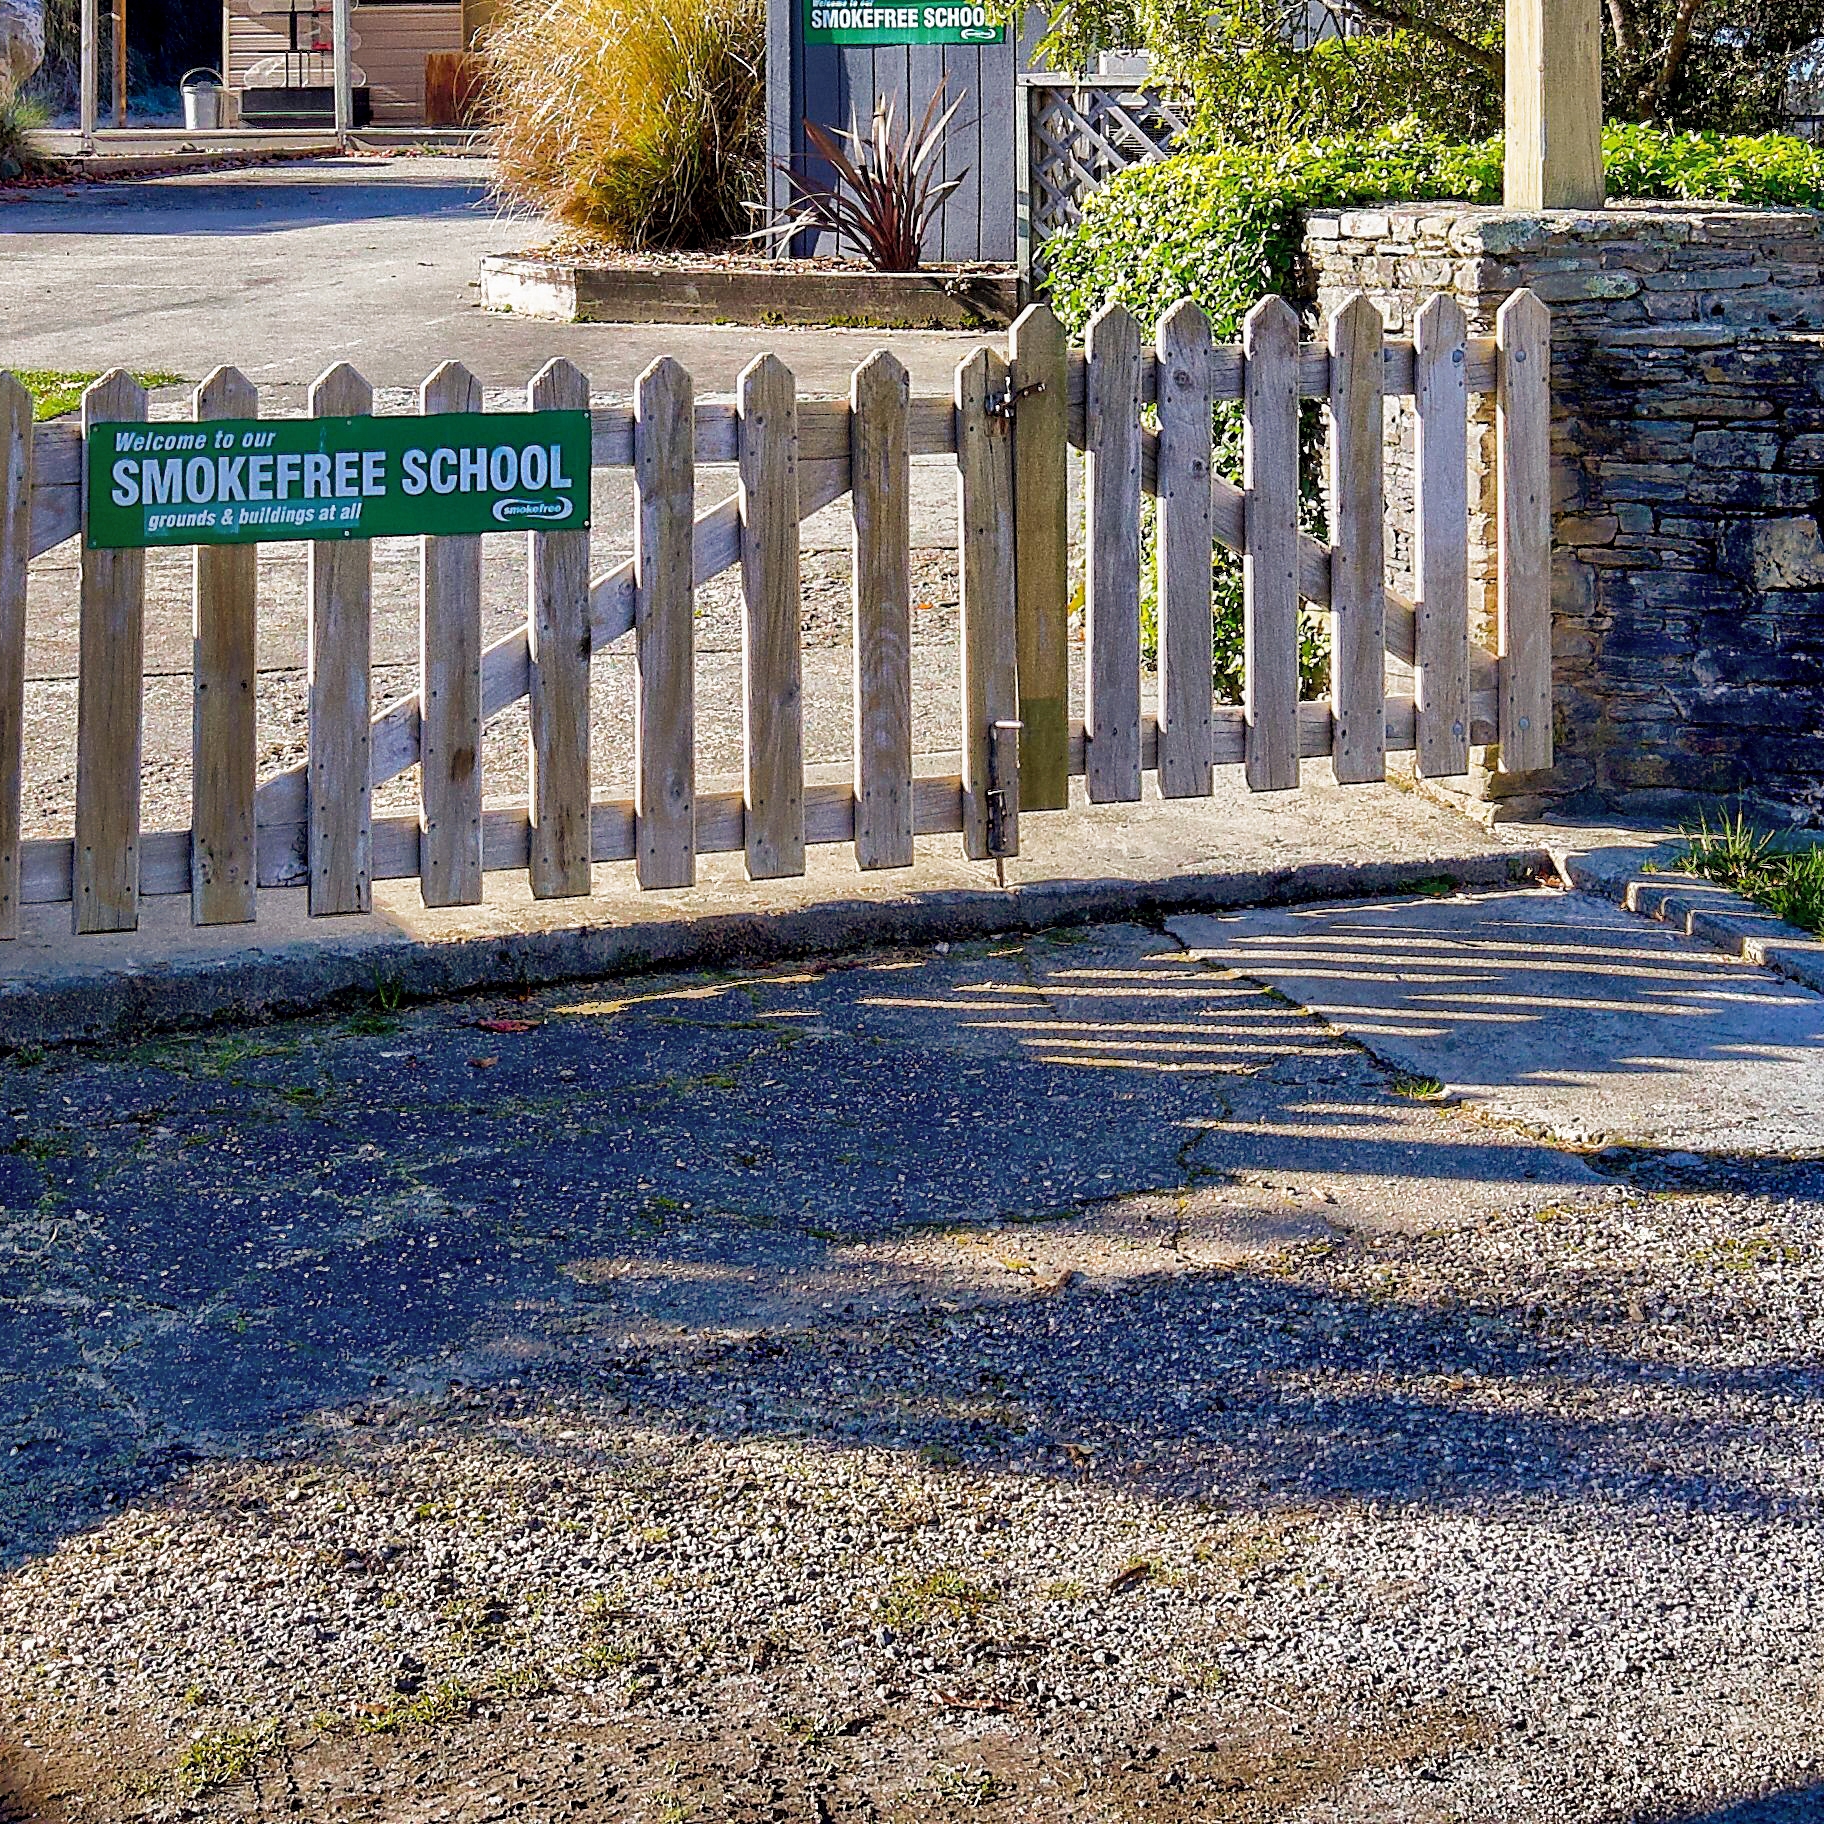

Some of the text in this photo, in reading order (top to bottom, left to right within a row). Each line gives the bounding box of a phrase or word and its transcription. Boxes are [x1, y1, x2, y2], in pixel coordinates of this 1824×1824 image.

[811, 7, 989, 28] SMOKEFREE SCHOO
[114, 430, 276, 452] Welcome to our
[111, 444, 573, 507] SMOKEFREE SCHOOL
[147, 502, 362, 532] grounds & buildings at all
[503, 503, 562, 516] smokefree
